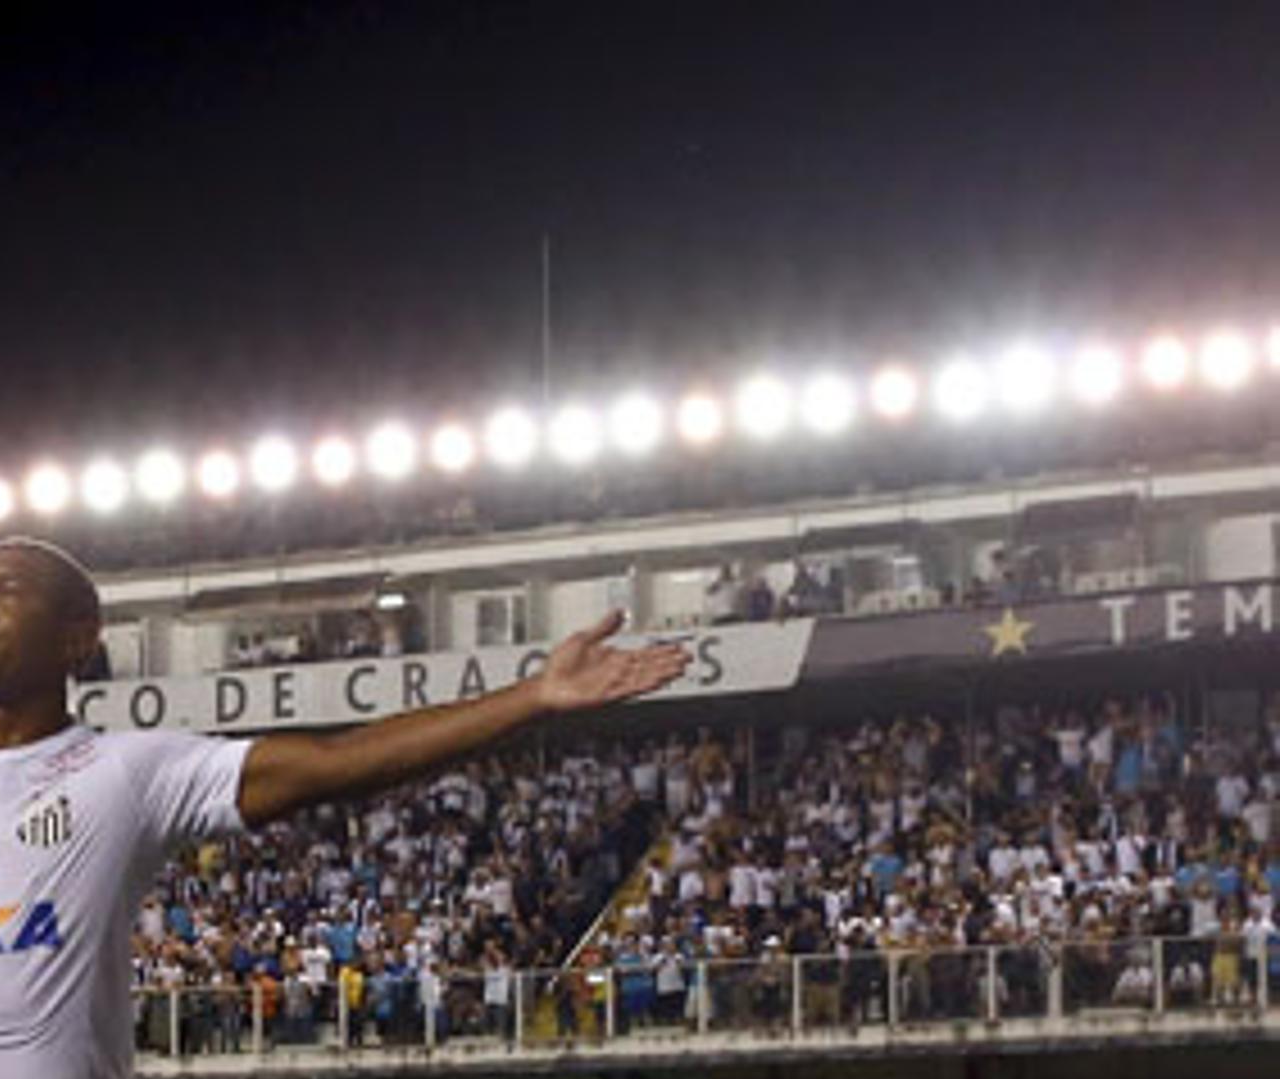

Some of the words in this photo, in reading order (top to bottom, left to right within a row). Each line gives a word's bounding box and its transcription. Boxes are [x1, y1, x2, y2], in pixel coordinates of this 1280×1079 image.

[1100, 583, 1273, 646] TEM
[216, 674, 295, 724] DE
[346, 635, 724, 712] CRAS
